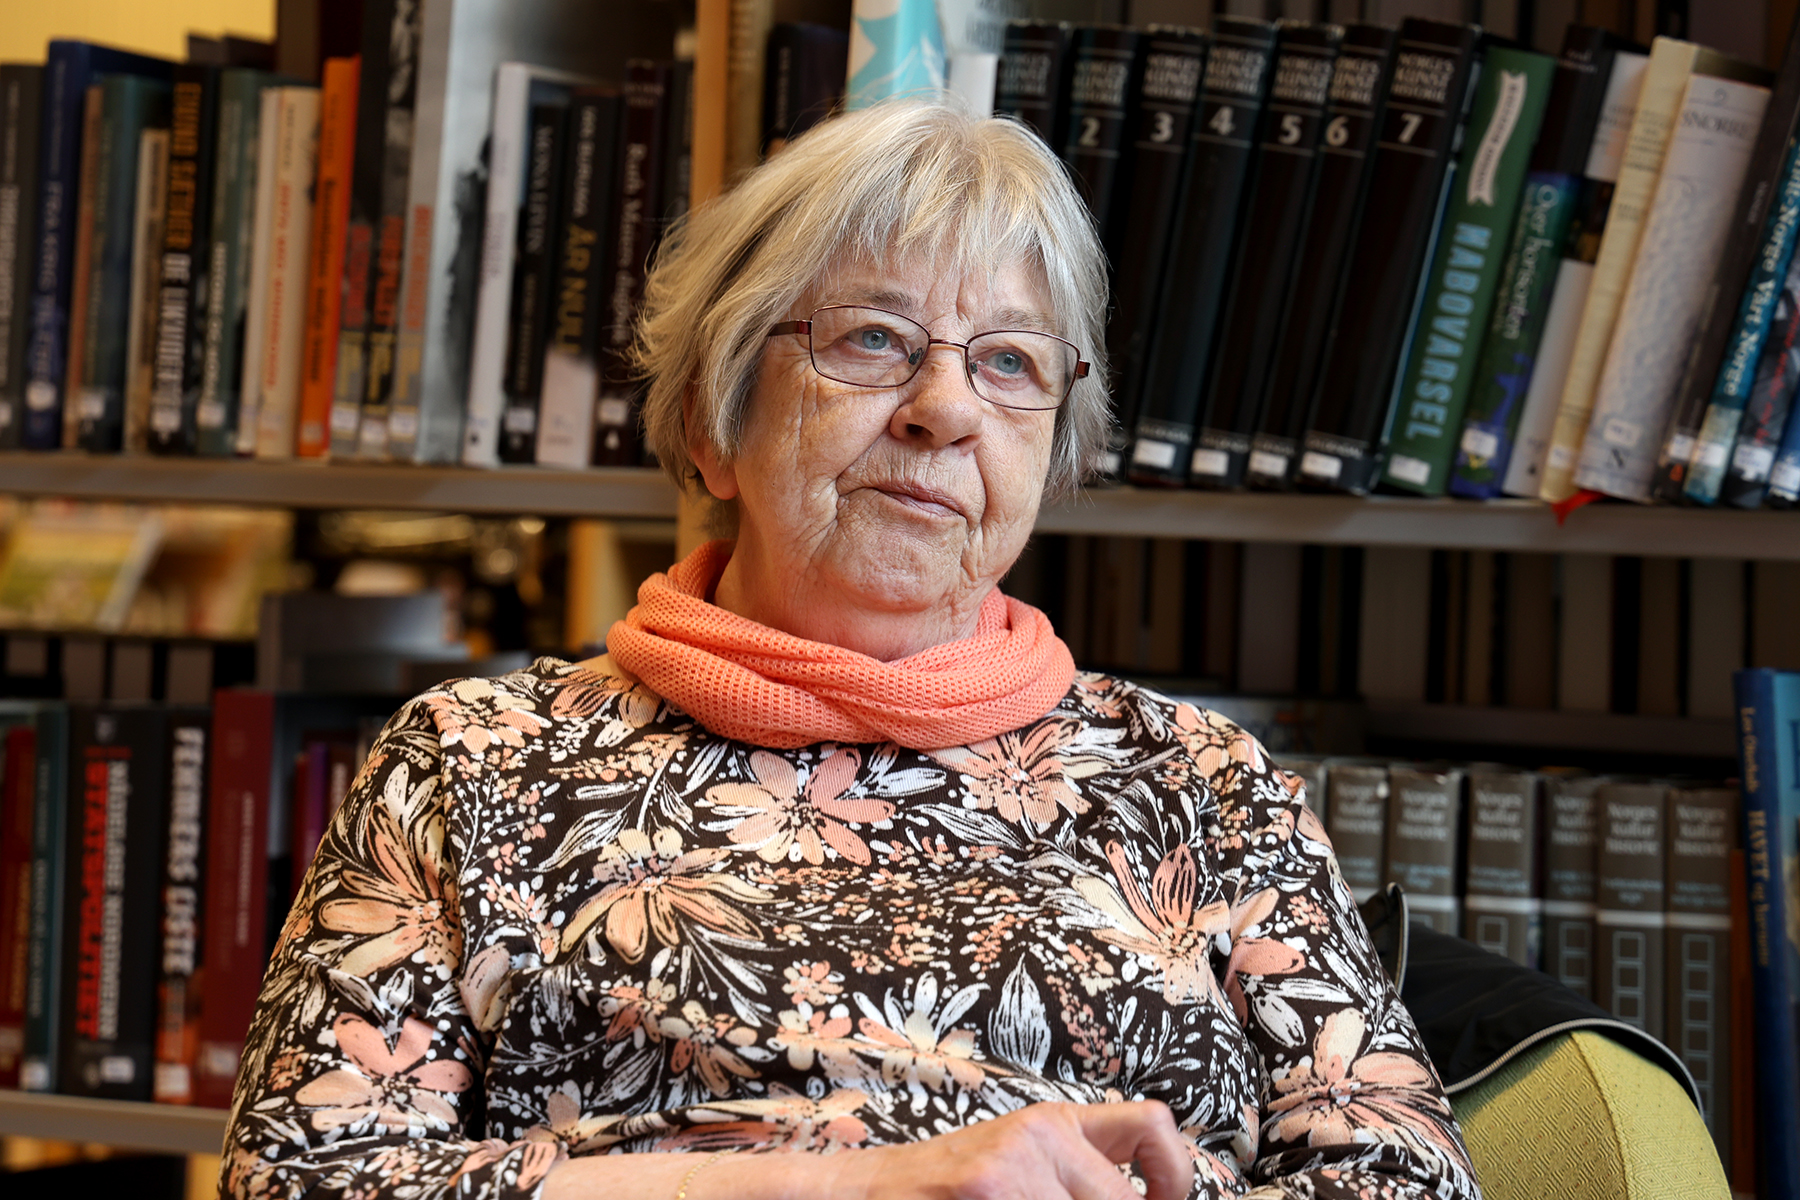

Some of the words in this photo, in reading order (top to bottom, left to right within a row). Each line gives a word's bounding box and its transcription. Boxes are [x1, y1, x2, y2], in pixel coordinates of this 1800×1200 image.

[1079, 117, 1099, 146] 2
[1152, 112, 1173, 142] 3
[1209, 105, 1236, 136] 4
[1279, 114, 1302, 145] 5
[1325, 115, 1349, 146] 6
[1398, 113, 1423, 143] 7
[526, 192, 548, 253] LEVIN
[1502, 238, 1555, 341] horisonten
[1745, 278, 1776, 325] Vårt
[1404, 222, 1492, 440] NABOVARSEL
[1723, 328, 1760, 397] Norge
[1749, 810, 1770, 879] HAVET
[163, 886, 197, 975] LISTE
